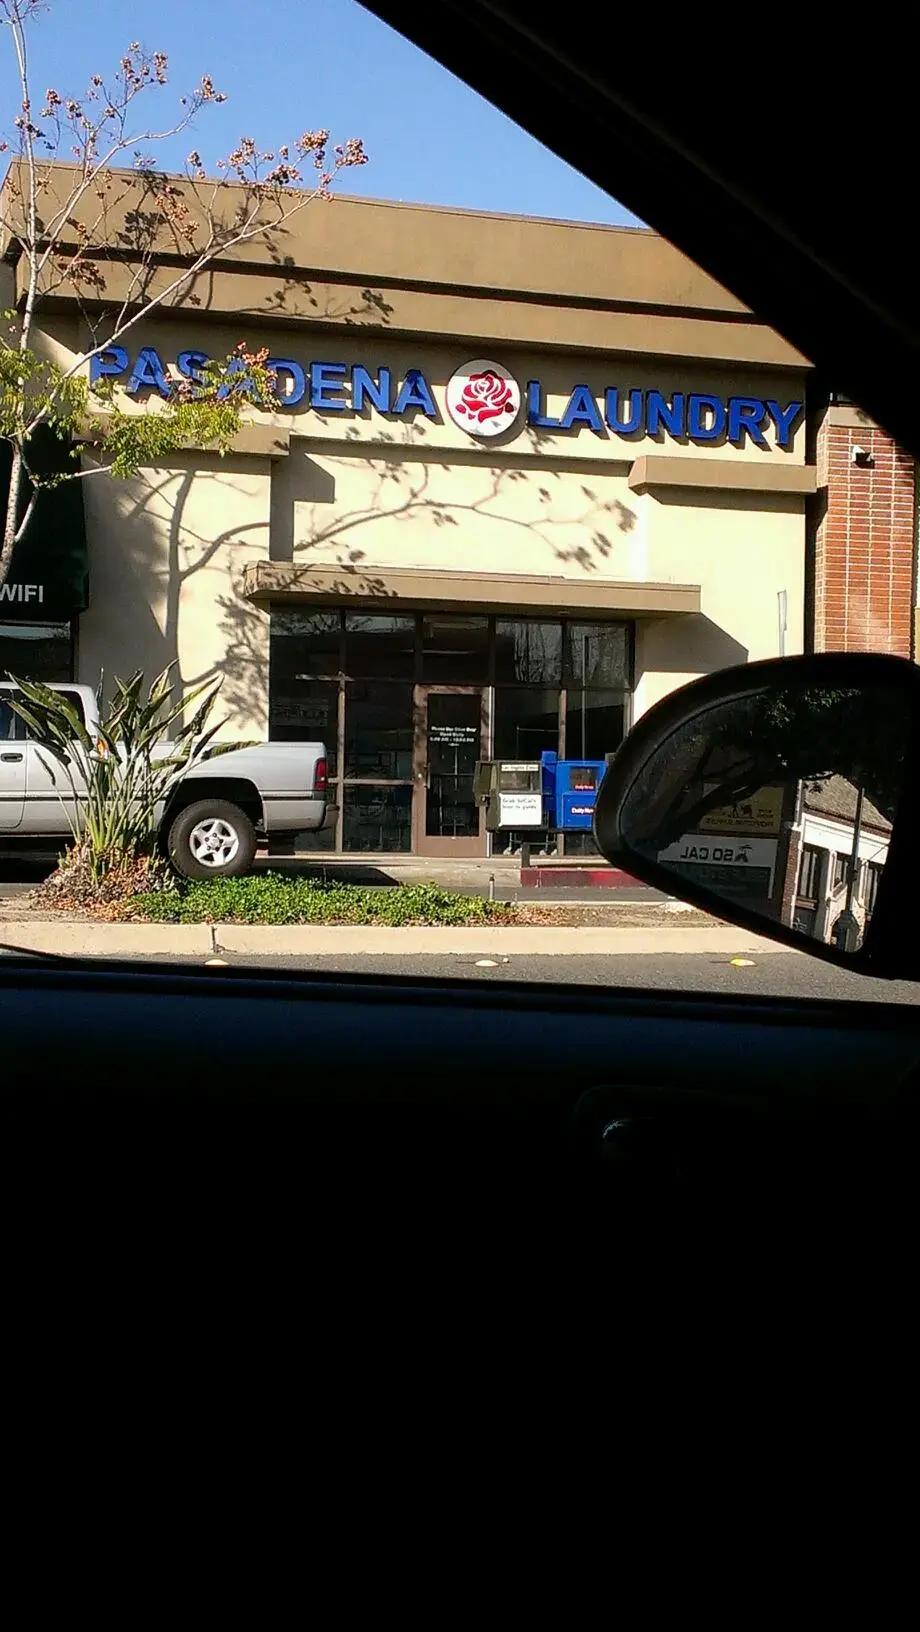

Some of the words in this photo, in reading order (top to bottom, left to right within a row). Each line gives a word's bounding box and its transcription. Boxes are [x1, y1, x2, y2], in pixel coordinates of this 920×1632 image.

[89, 343, 436, 417] PASADENA
[526, 379, 804, 446] LAUNDRY
[0, 583, 44, 603] WIFI
